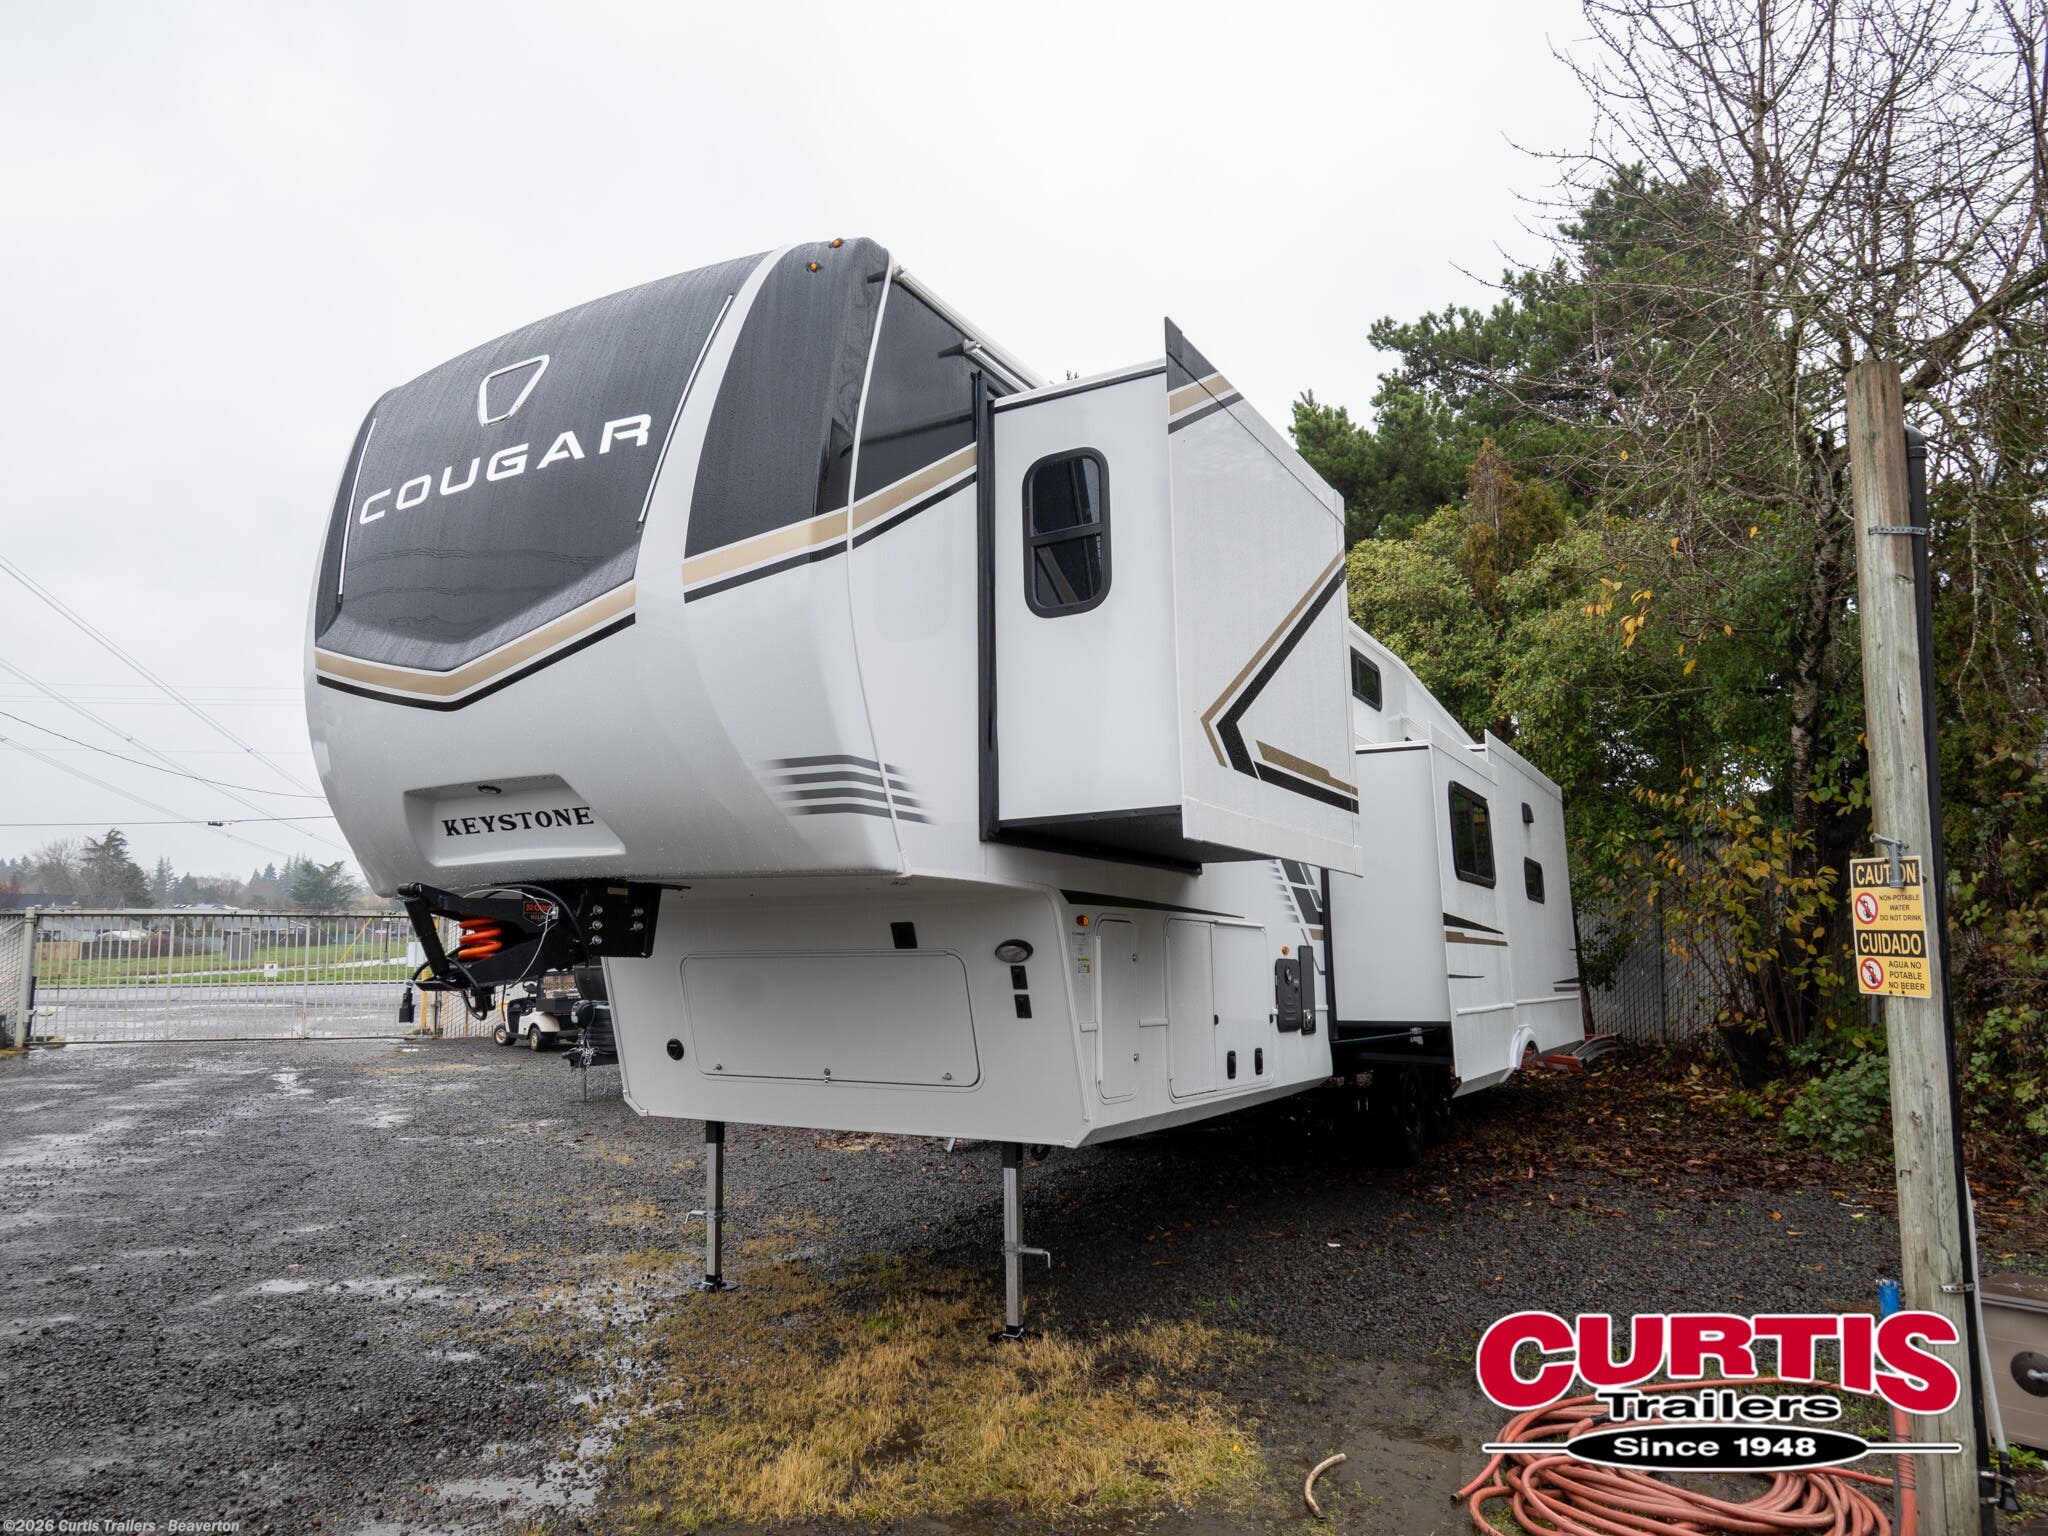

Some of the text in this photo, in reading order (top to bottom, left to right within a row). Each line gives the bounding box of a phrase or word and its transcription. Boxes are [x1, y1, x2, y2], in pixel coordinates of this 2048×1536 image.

[358, 414, 652, 525] COUGAR
[441, 806, 594, 837] KEYSTONE
[1855, 862, 1917, 885] CAUTON
[1860, 932, 1922, 955] CUIDADO
[1888, 960, 1922, 970] AGUA NO
[1889, 970, 1922, 980] POTABLE
[1888, 981, 1926, 991] NO BEBER
